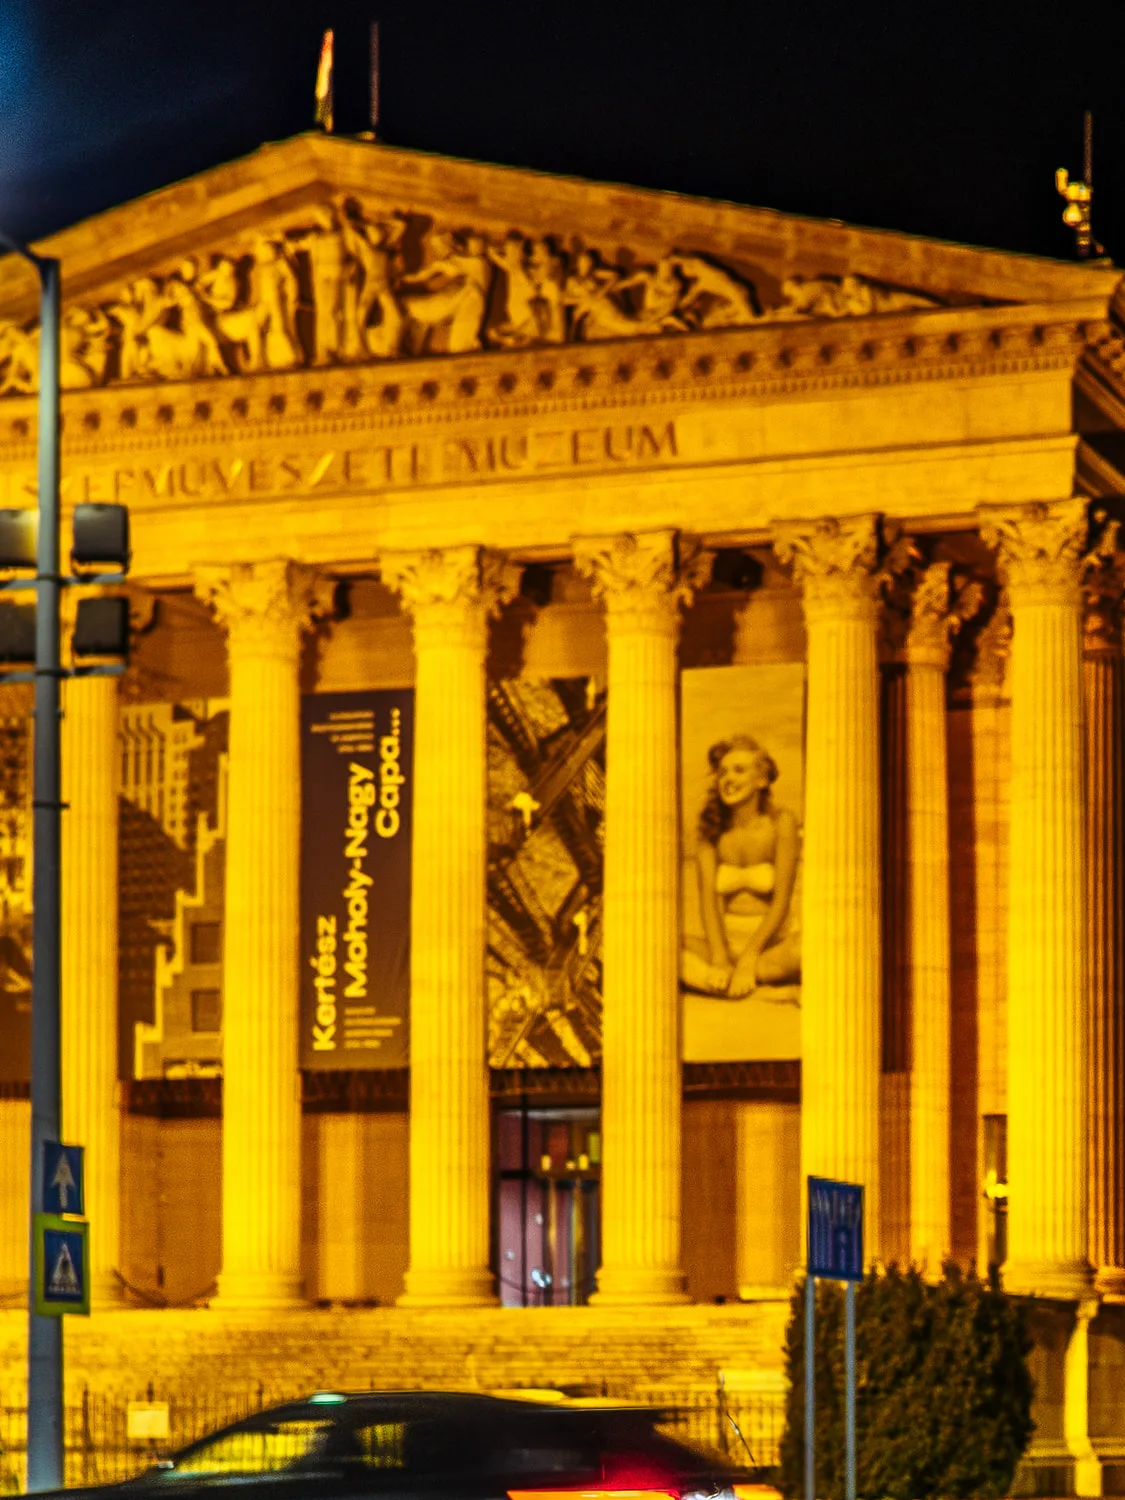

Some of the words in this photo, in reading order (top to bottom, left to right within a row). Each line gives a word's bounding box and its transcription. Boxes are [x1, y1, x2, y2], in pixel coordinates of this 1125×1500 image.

[376, 707, 405, 839] Capa...
[342, 762, 376, 998] Moholy-Nagy
[309, 914, 337, 1051] Kertész
